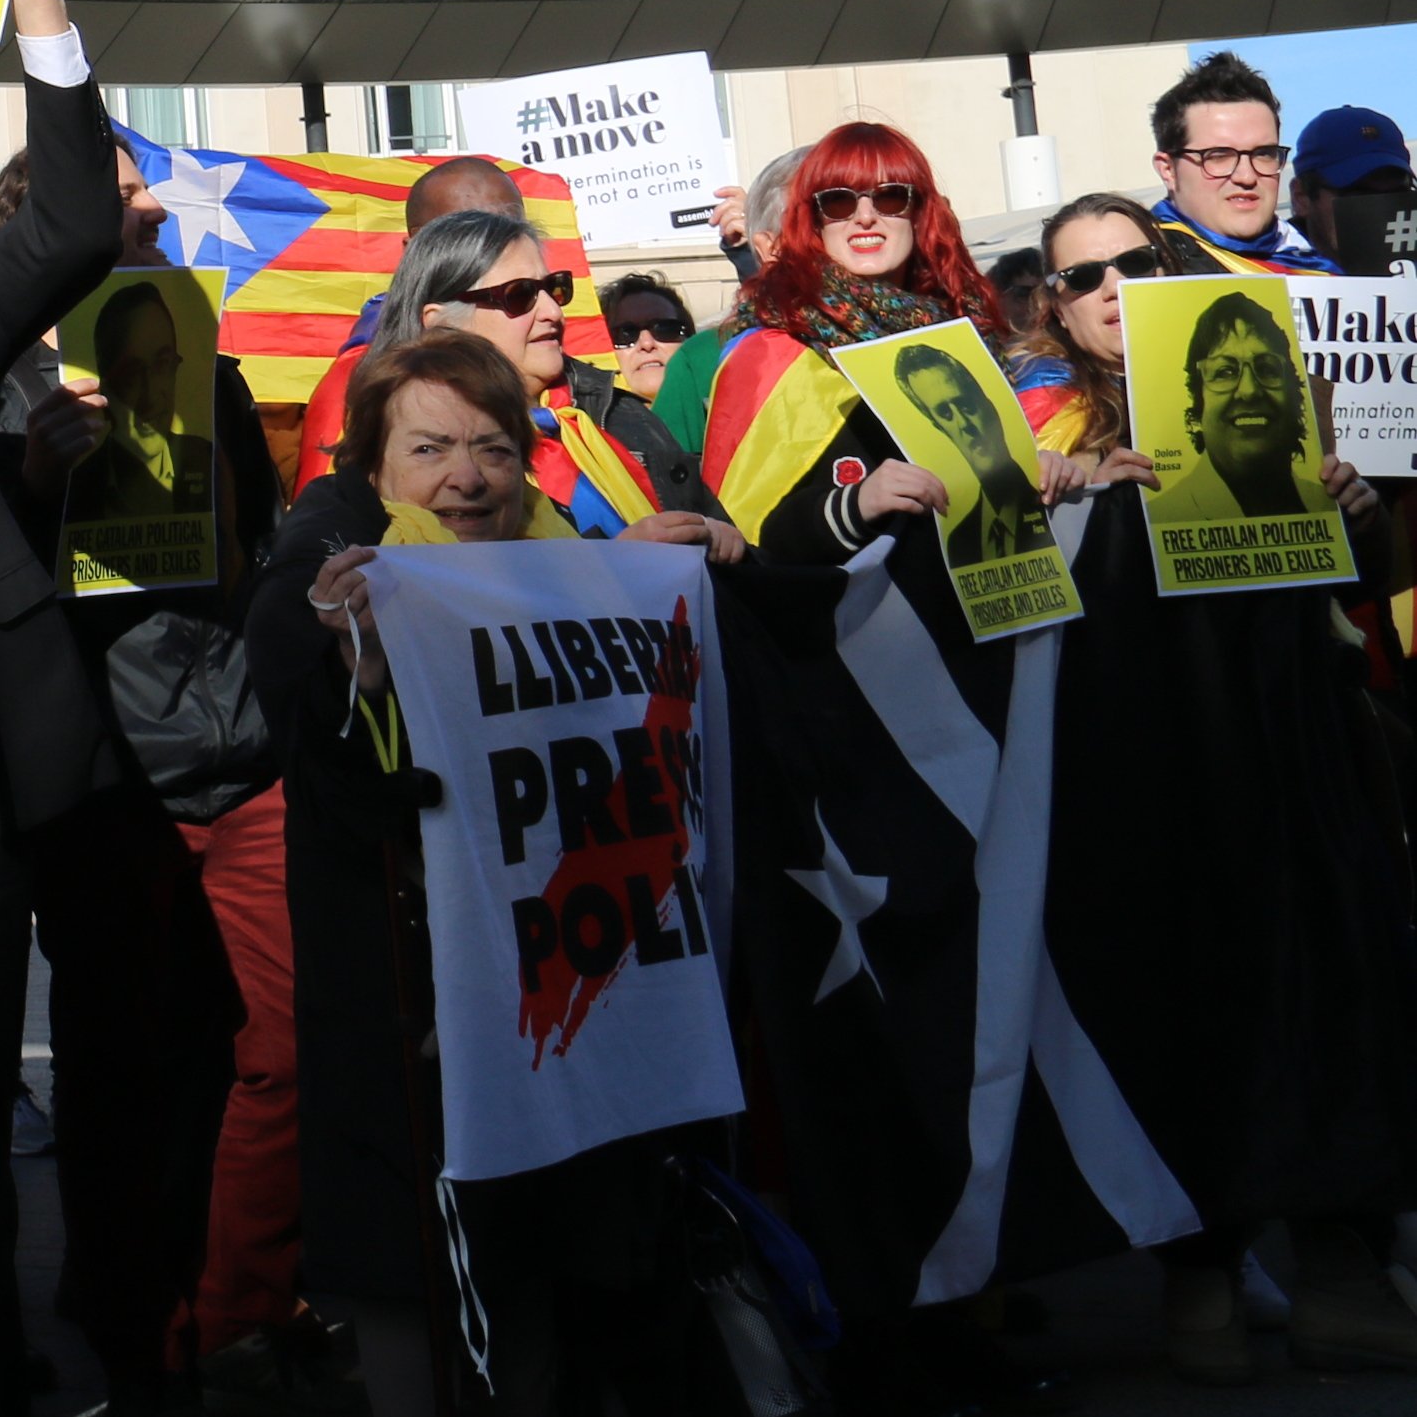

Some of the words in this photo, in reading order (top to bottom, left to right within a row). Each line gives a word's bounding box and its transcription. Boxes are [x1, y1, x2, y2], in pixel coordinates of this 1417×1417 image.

[516, 84, 662, 134] #Make
[521, 139, 547, 165] a
[552, 119, 667, 161] move
[567, 161, 680, 190] termination
[688, 155, 703, 171] is
[587, 188, 619, 207] not
[626, 188, 639, 200] a
[647, 178, 701, 196] crime
[1358, 427, 1369, 440] a
[1378, 421, 1417, 440] crim
[1154, 448, 1182, 458] Dolors
[1154, 462, 1181, 472] Bassa
[68, 529, 93, 552] FREE
[95, 525, 142, 550] CATALAN
[147, 519, 205, 544] POLITICAL
[1161, 528, 1197, 553] FREE
[1198, 524, 1259, 550] CATALAN
[1261, 519, 1334, 545] POLITICAL
[71, 553, 131, 582] PRISONERS
[135, 553, 157, 574] AND
[162, 550, 201, 573] EXILES
[958, 572, 980, 598] FREE
[978, 565, 1015, 593] CATALAN
[1012, 555, 1061, 584] POLITICAL
[1173, 554, 1251, 582] PRISONERS
[1254, 551, 1283, 574] AND
[1285, 548, 1336, 572] EXILES
[971, 596, 1015, 627] PRISONERS
[1013, 592, 1034, 617] AND
[1032, 584, 1067, 611] EXILES
